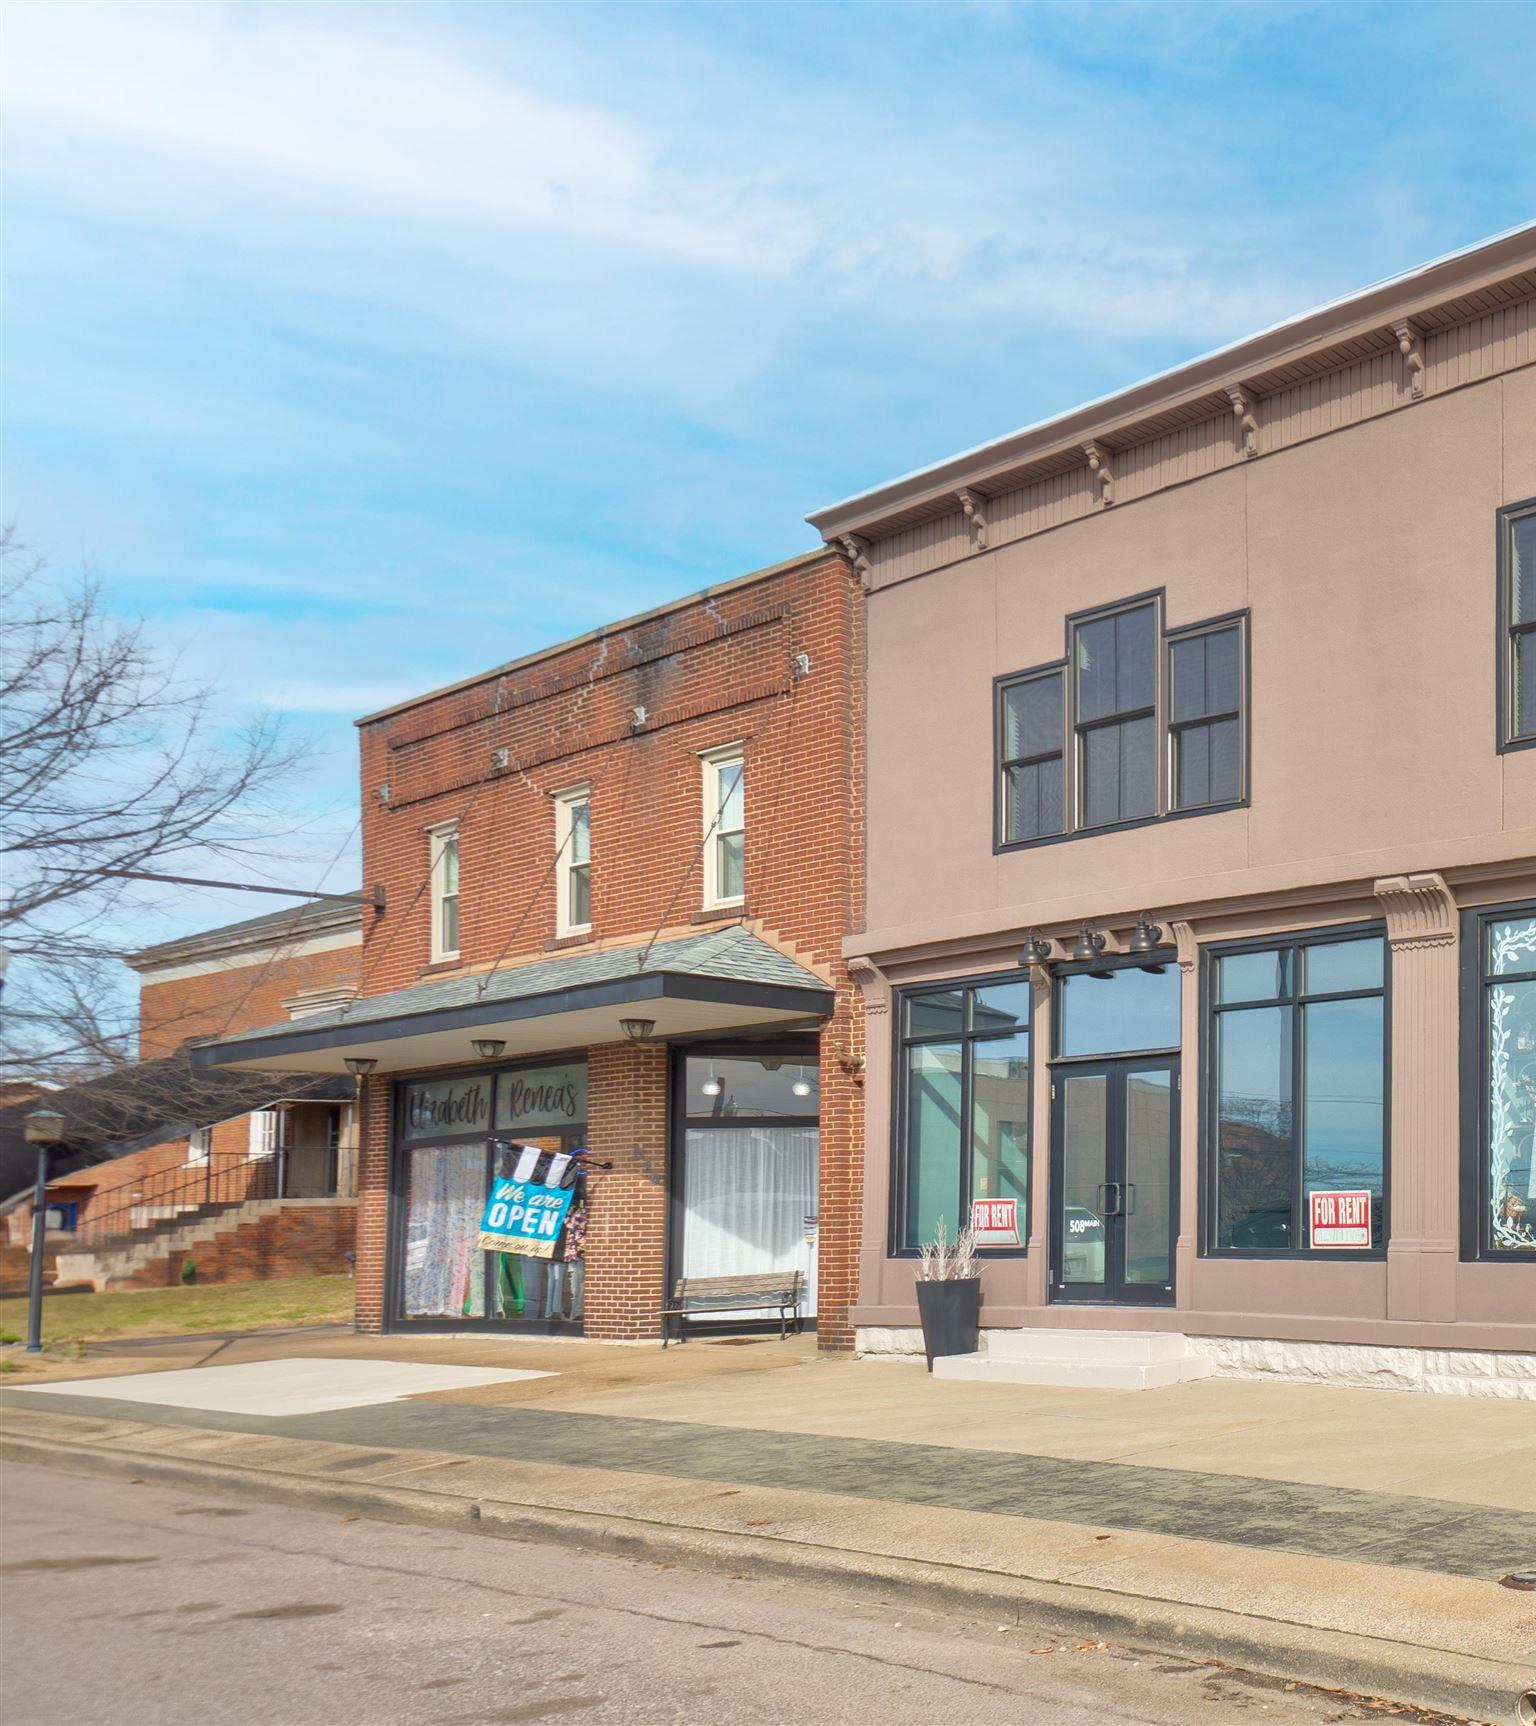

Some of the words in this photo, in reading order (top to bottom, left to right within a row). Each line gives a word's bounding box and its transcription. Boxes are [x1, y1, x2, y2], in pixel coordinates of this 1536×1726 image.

[495, 1183, 526, 1203] We
[528, 1194, 564, 1209] are
[488, 1202, 560, 1236] OPEN
[974, 1204, 990, 1229] FOR
[991, 1204, 1014, 1229] RENT
[1314, 1196, 1336, 1225] FOR
[1338, 1196, 1367, 1225] RENT
[1069, 1219, 1085, 1233] 508
[1085, 1219, 1100, 1227] MAIN
